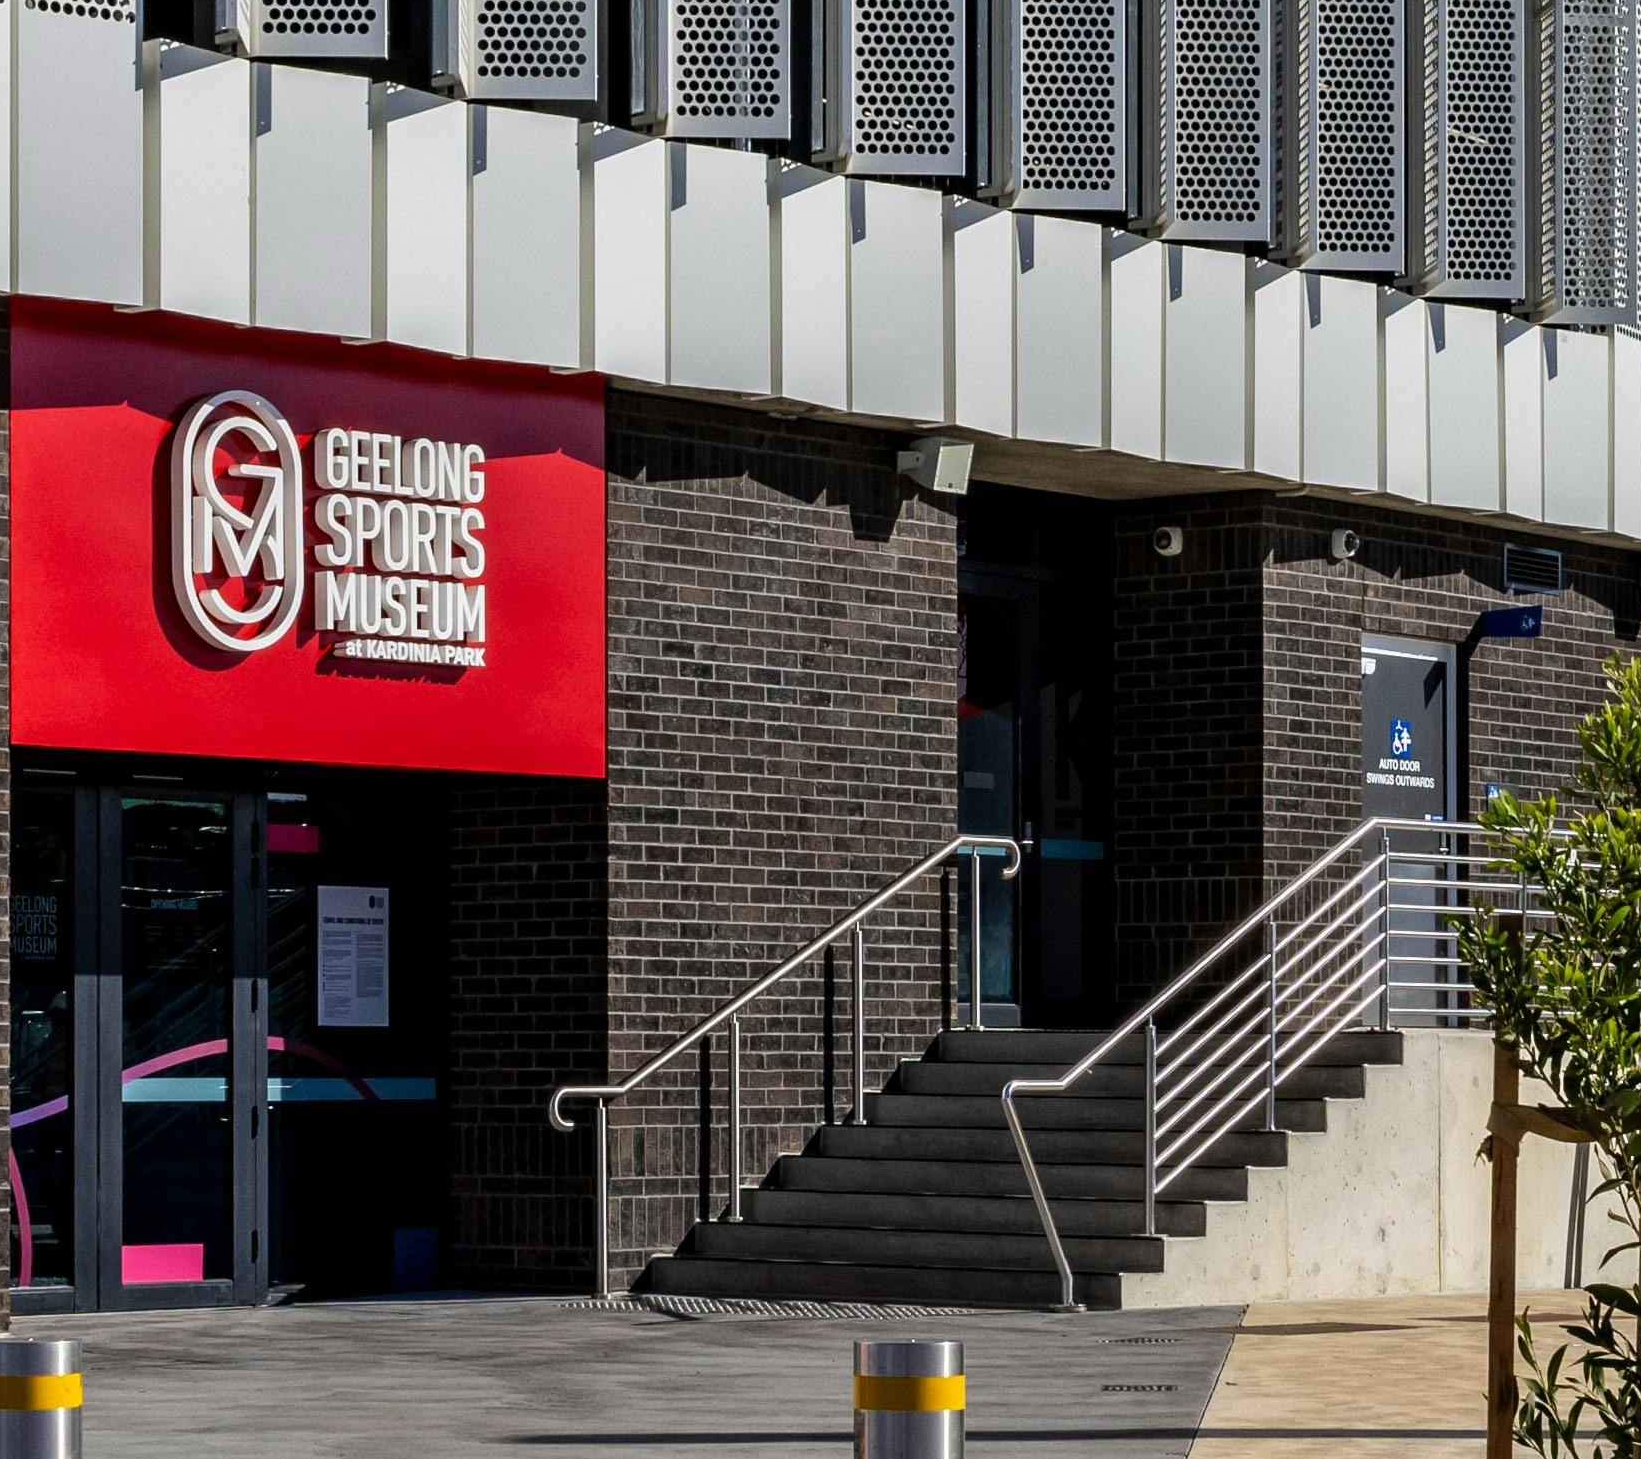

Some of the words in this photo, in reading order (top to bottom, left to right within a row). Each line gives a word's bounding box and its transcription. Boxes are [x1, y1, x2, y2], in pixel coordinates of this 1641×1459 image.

[316, 427, 486, 504] GEELONG
[316, 493, 486, 579] SPORTS
[316, 570, 486, 643] MUSEUM
[343, 639, 363, 658] at
[366, 639, 440, 664] KARDINIA
[444, 645, 487, 667] PARK
[1366, 772, 1395, 786] SWINGS
[1395, 775, 1435, 789] OUTWARDS
[1379, 758, 1399, 770] AUTO
[1400, 760, 1421, 772] DOOR
